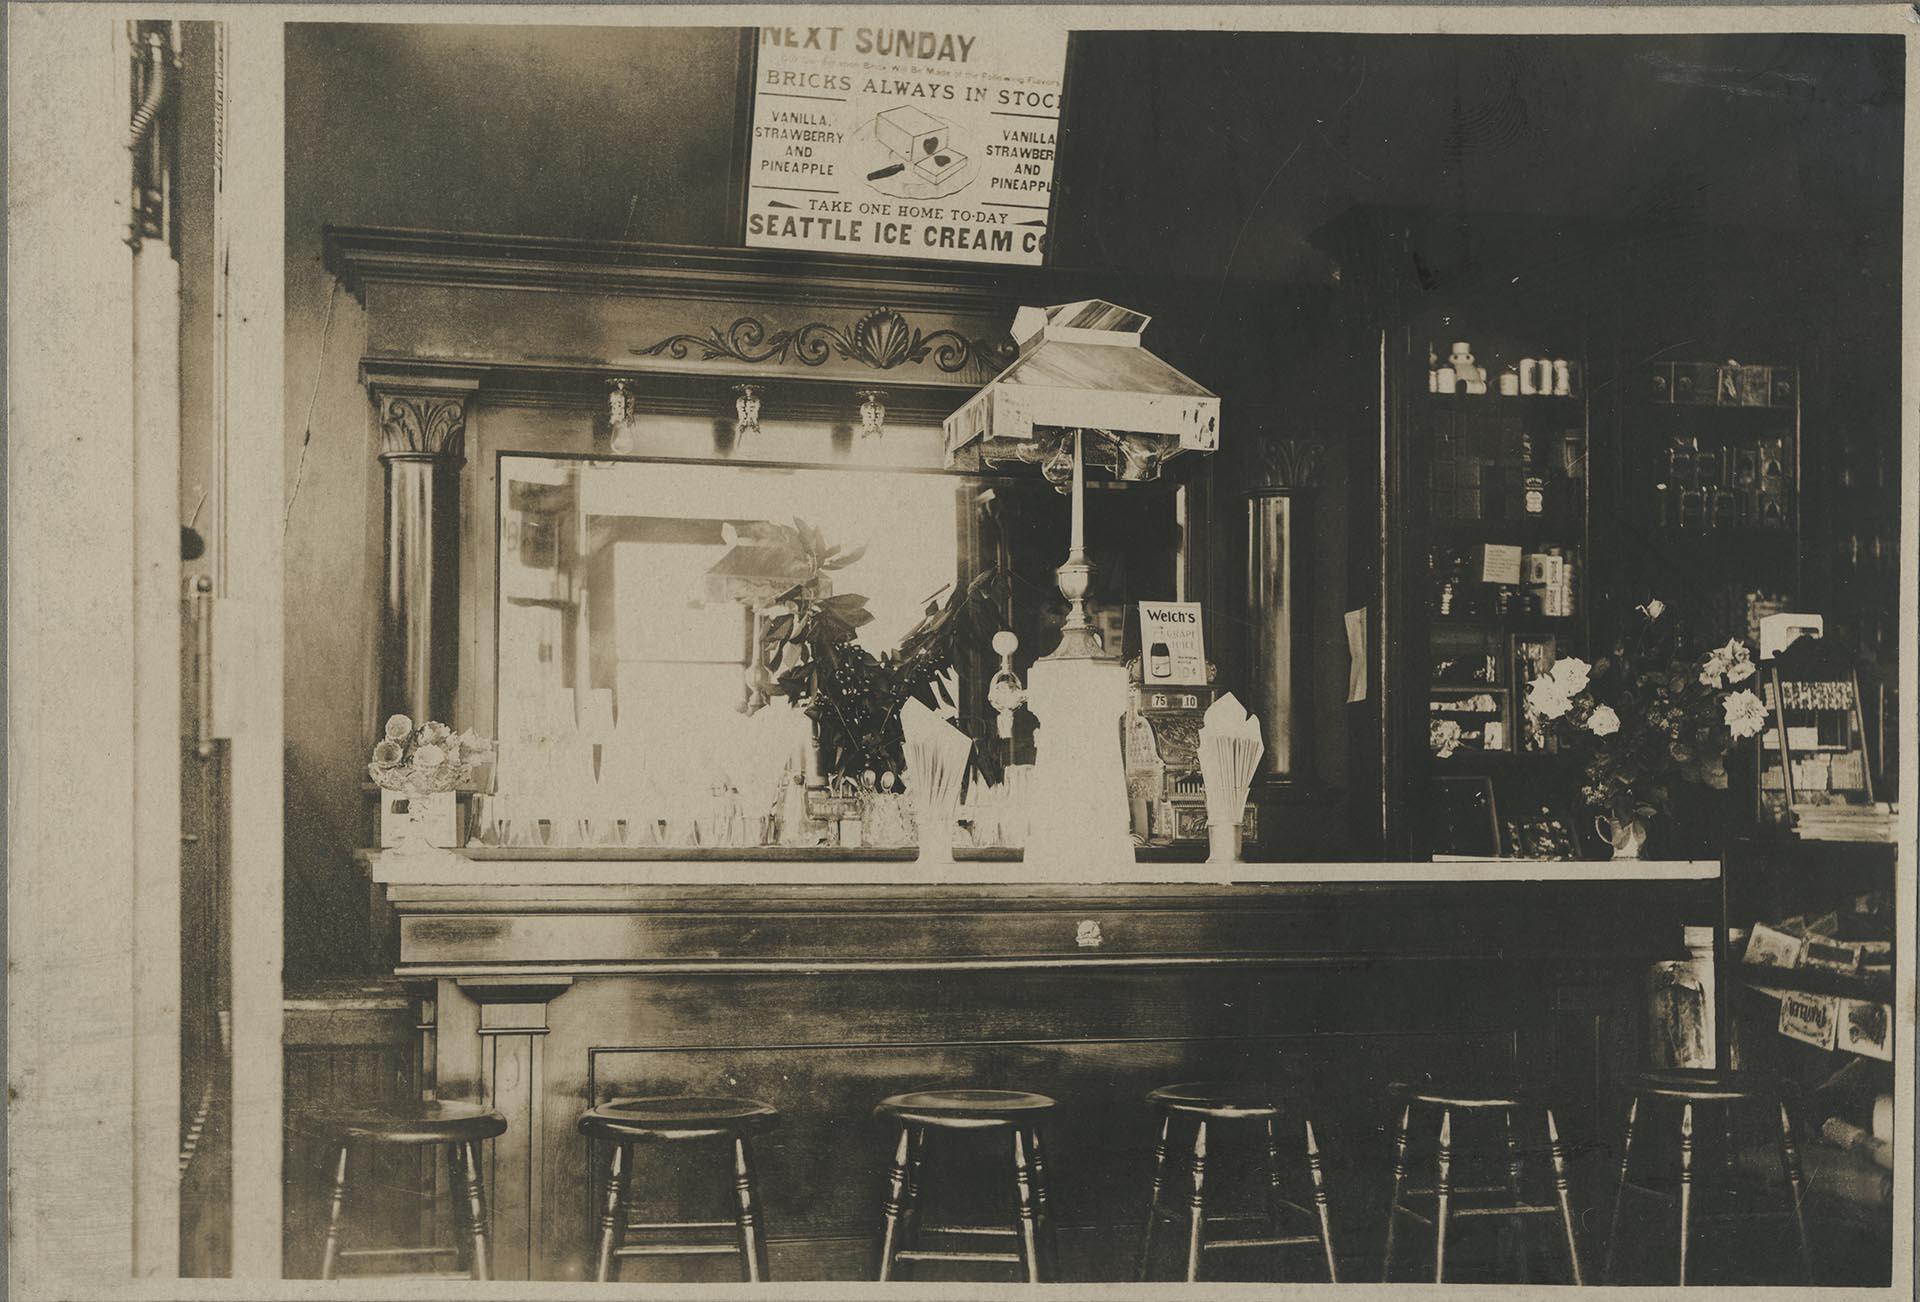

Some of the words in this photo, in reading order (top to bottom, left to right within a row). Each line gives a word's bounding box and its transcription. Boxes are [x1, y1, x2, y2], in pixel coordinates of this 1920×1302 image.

[761, 26, 844, 51] NEXT
[855, 27, 976, 63] SUNDAY
[766, 69, 852, 91] BRICKS
[862, 78, 955, 100] ALWAYS
[966, 86, 989, 102] IN
[755, 126, 844, 144] STRAWBERRY
[1003, 129, 1055, 145] VANILLA
[785, 145, 813, 158] AND
[761, 160, 834, 176] PINEAPPLE
[1014, 163, 1041, 176] AND
[809, 199, 853, 213] TAKE
[859, 202, 892, 216] ONE
[898, 205, 944, 220] HOME
[749, 213, 863, 242] SEATTLE
[874, 221, 913, 245] ICE
[923, 225, 1014, 252] CREAM
[1147, 609, 1196, 624] Welch's
